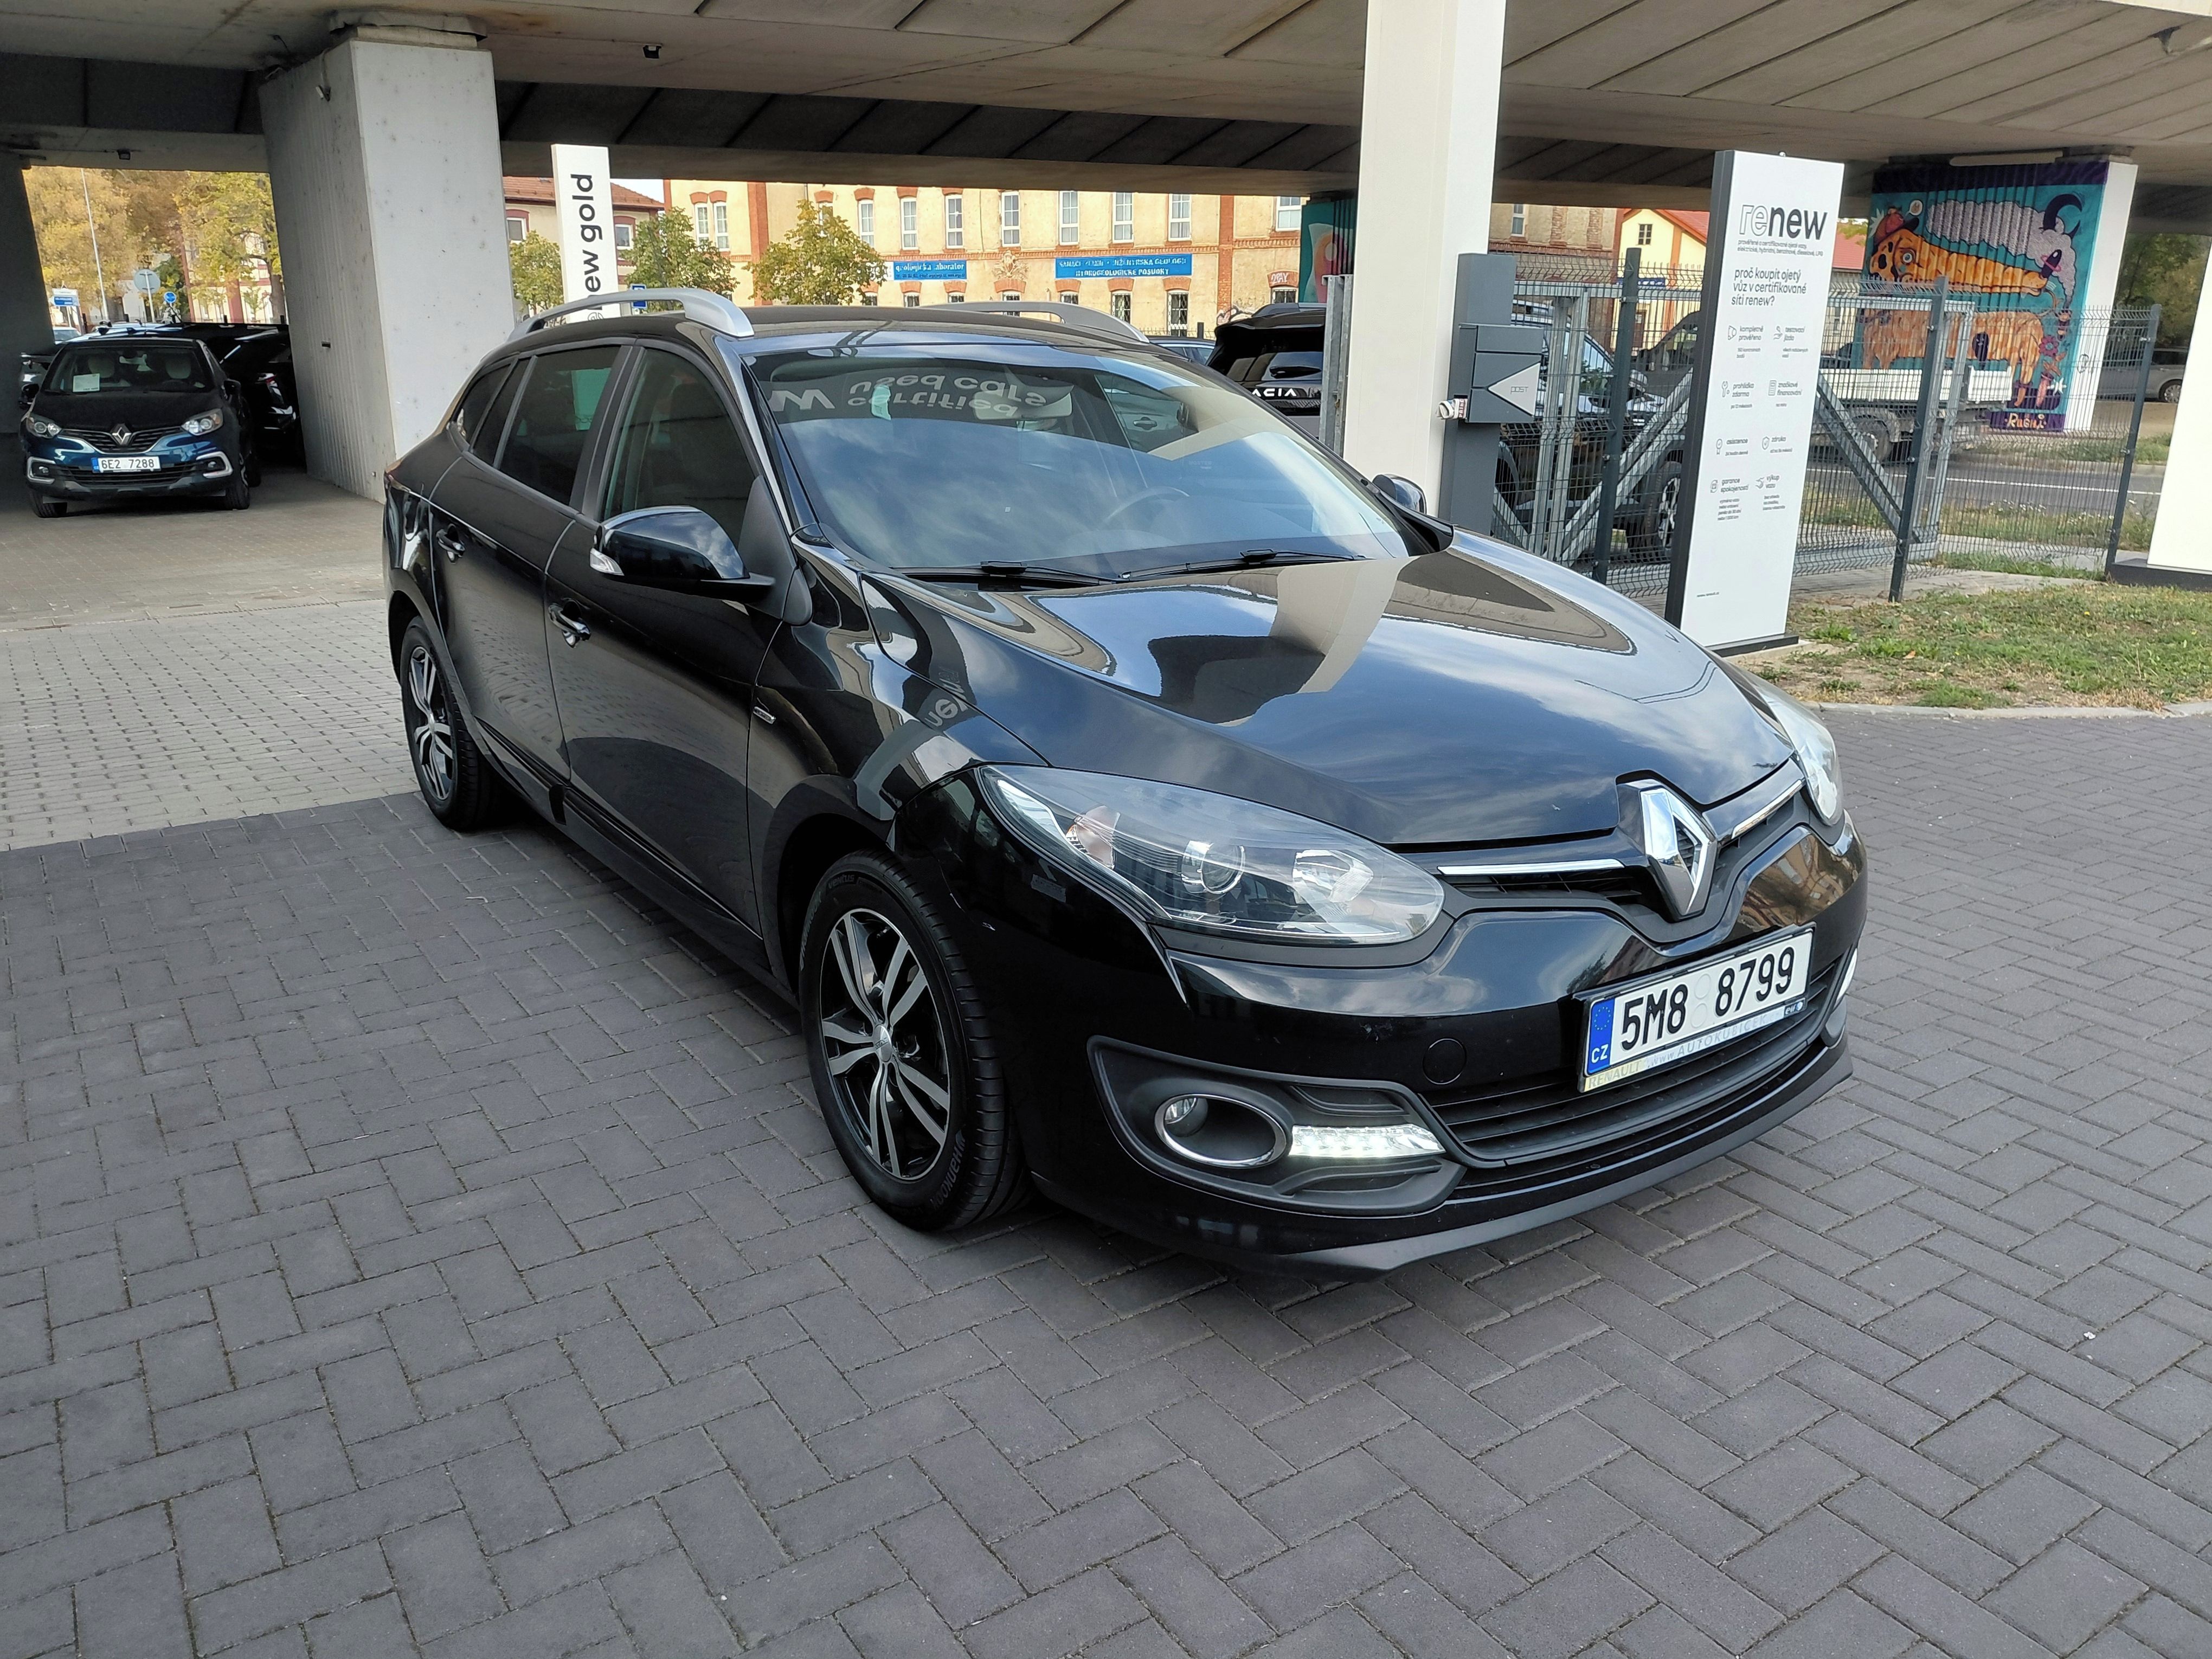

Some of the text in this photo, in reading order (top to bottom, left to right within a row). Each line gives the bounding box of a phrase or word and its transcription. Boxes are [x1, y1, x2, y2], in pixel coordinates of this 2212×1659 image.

[570, 173, 603, 242] gold
[1739, 204, 1828, 240] renew
[1734, 267, 1801, 283] proč koupit ojetý
[1733, 280, 1806, 294] vůz v certifikované
[1731, 294, 1775, 306] síti renew?
[1252, 388, 1297, 397] ACIA
[101, 460, 121, 469] 6E2
[128, 459, 155, 468] 7288
[1621, 946, 1795, 1051] 5M8 8799
[1591, 1044, 1608, 1063] CZ
[1588, 1060, 1641, 1090] RENAULT
